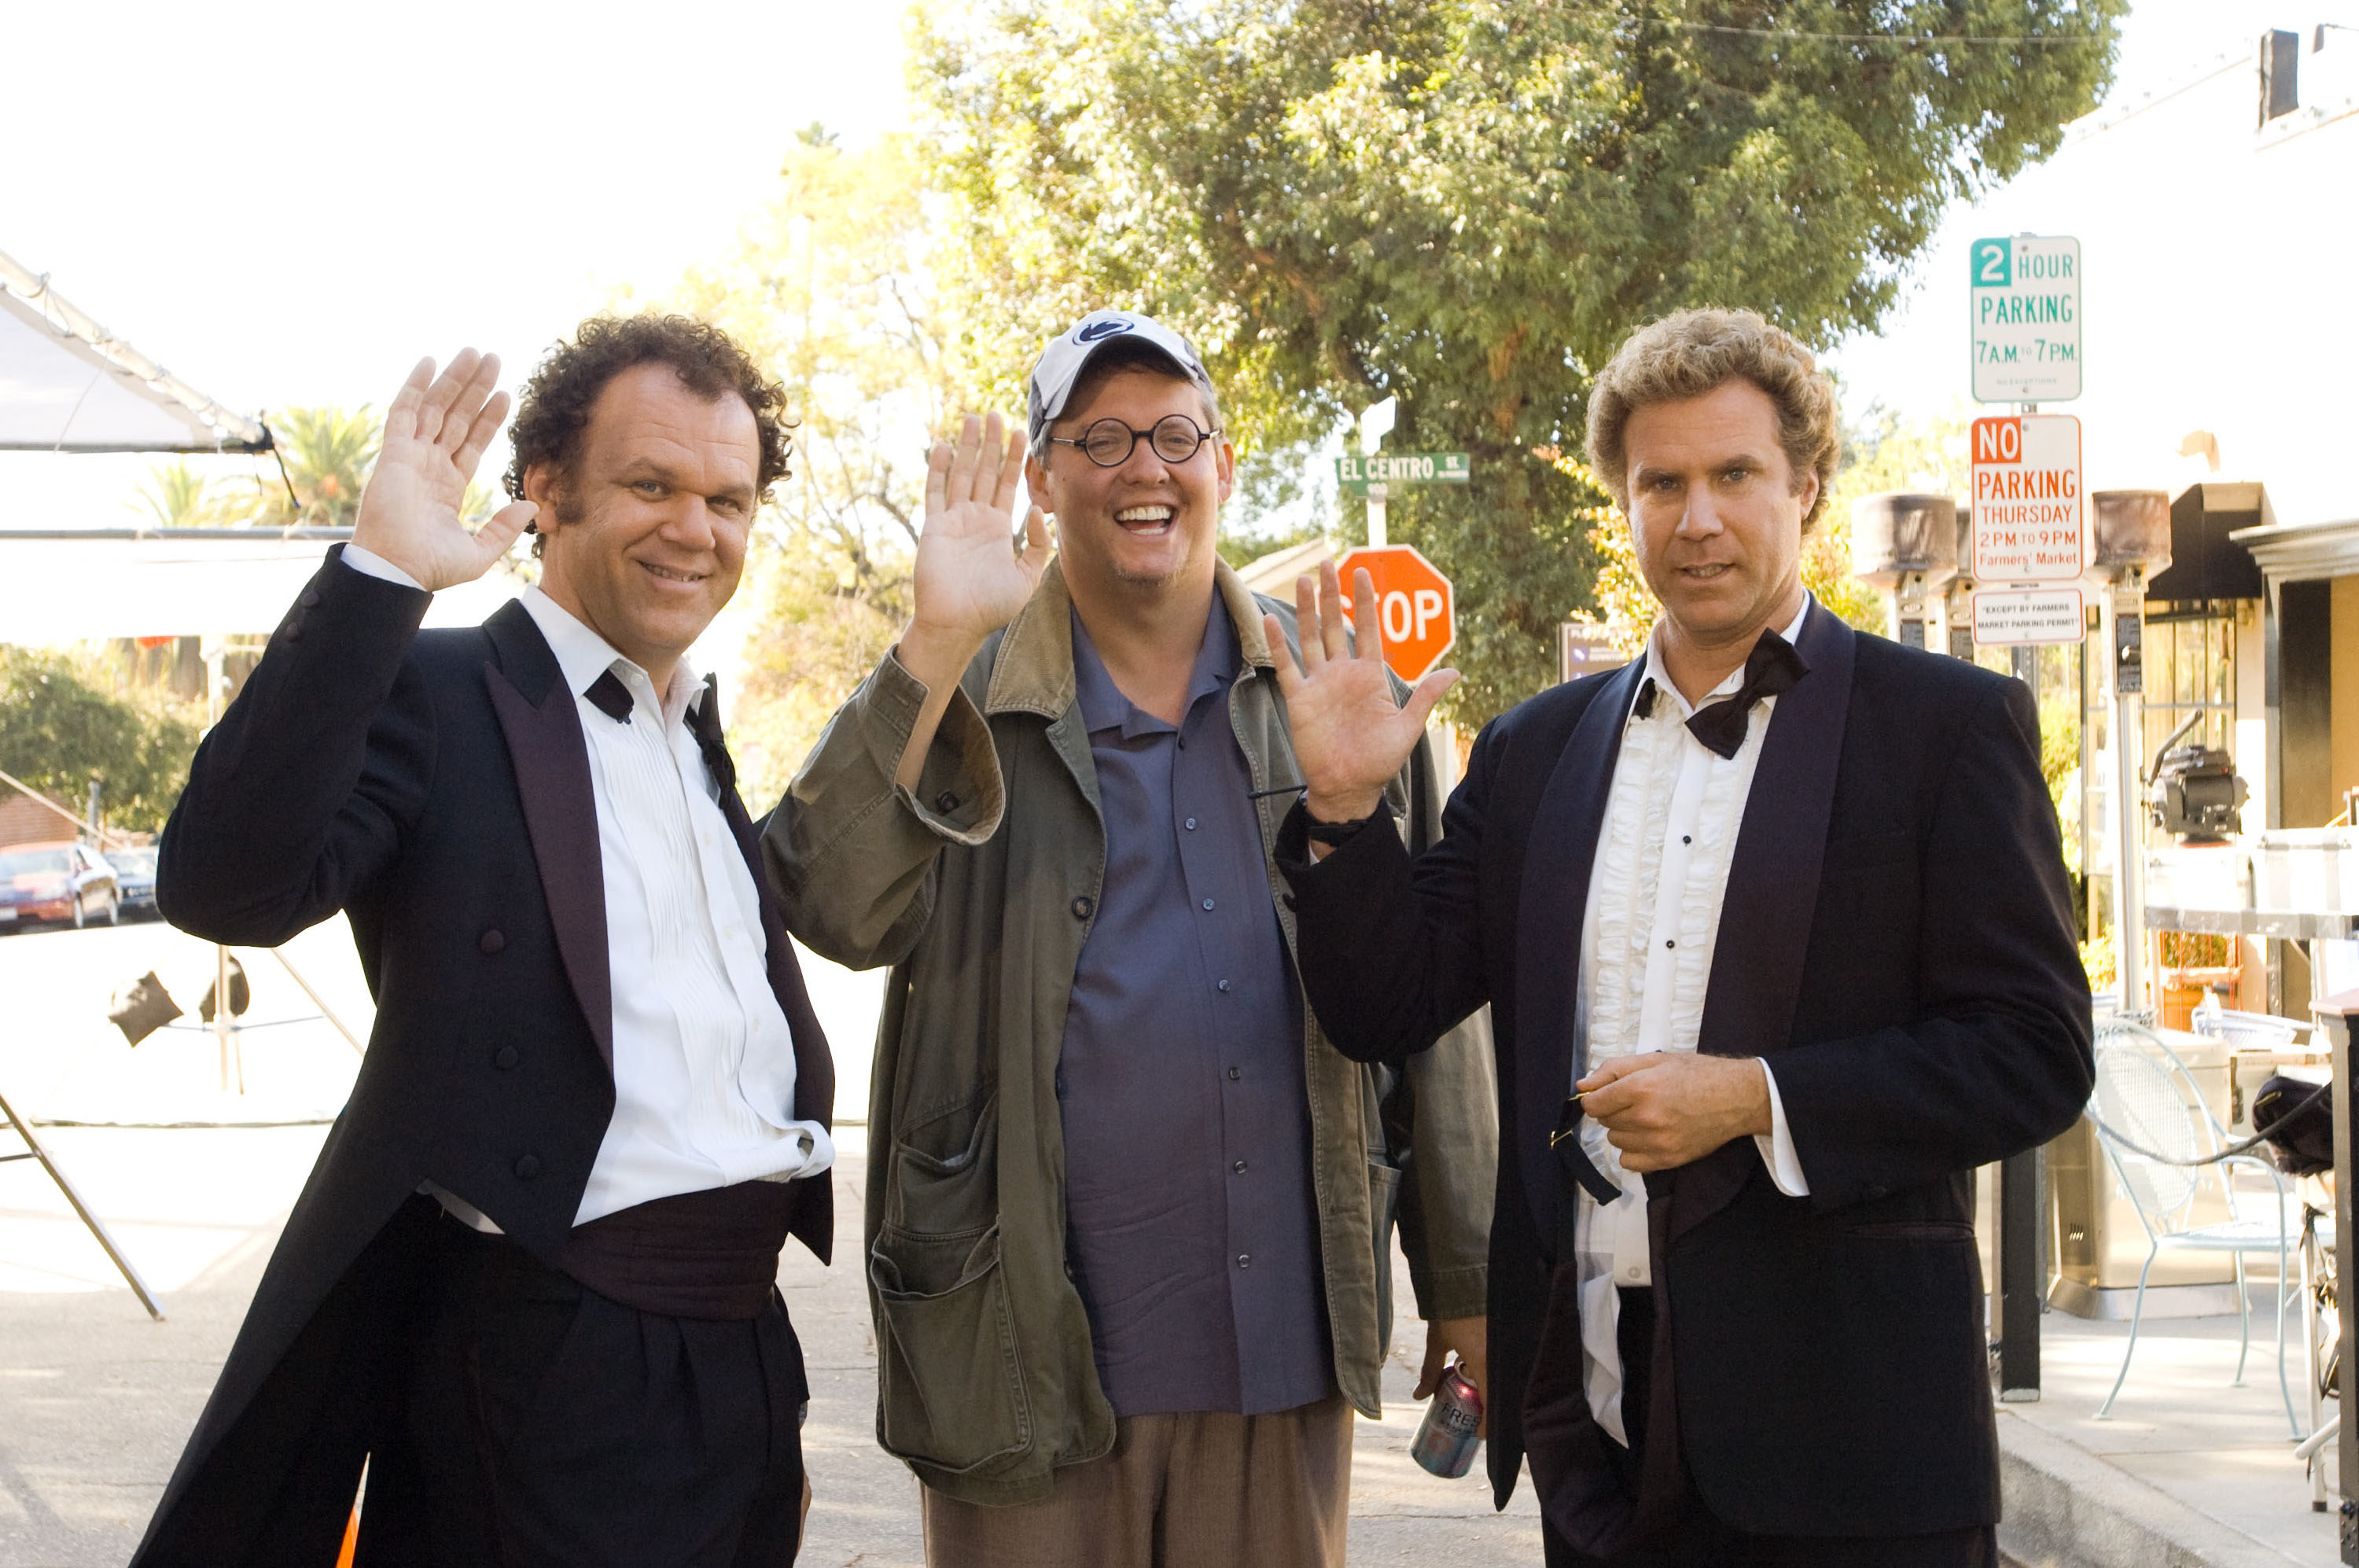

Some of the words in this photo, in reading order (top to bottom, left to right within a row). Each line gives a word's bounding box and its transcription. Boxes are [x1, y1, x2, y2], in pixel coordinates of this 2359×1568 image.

[1980, 245, 2005, 282] 2
[2019, 254, 2074, 279] HOUR
[1981, 294, 2073, 325] PARKING
[1978, 422, 2019, 460] NO
[1339, 458, 1363, 480] EL
[1365, 456, 1434, 480] CENTRO
[1978, 469, 2076, 500] PARKING
[1982, 505, 2073, 525] THURSDAY
[2022, 533, 2035, 544] TO
[1980, 551, 2033, 565] Farmers'
[2037, 551, 2077, 565] Market
[2019, 605, 2030, 613] BY
[2032, 602, 2070, 613] FARMERS
[1977, 620, 2009, 629] MARKET
[2011, 620, 2045, 628] PARKING
